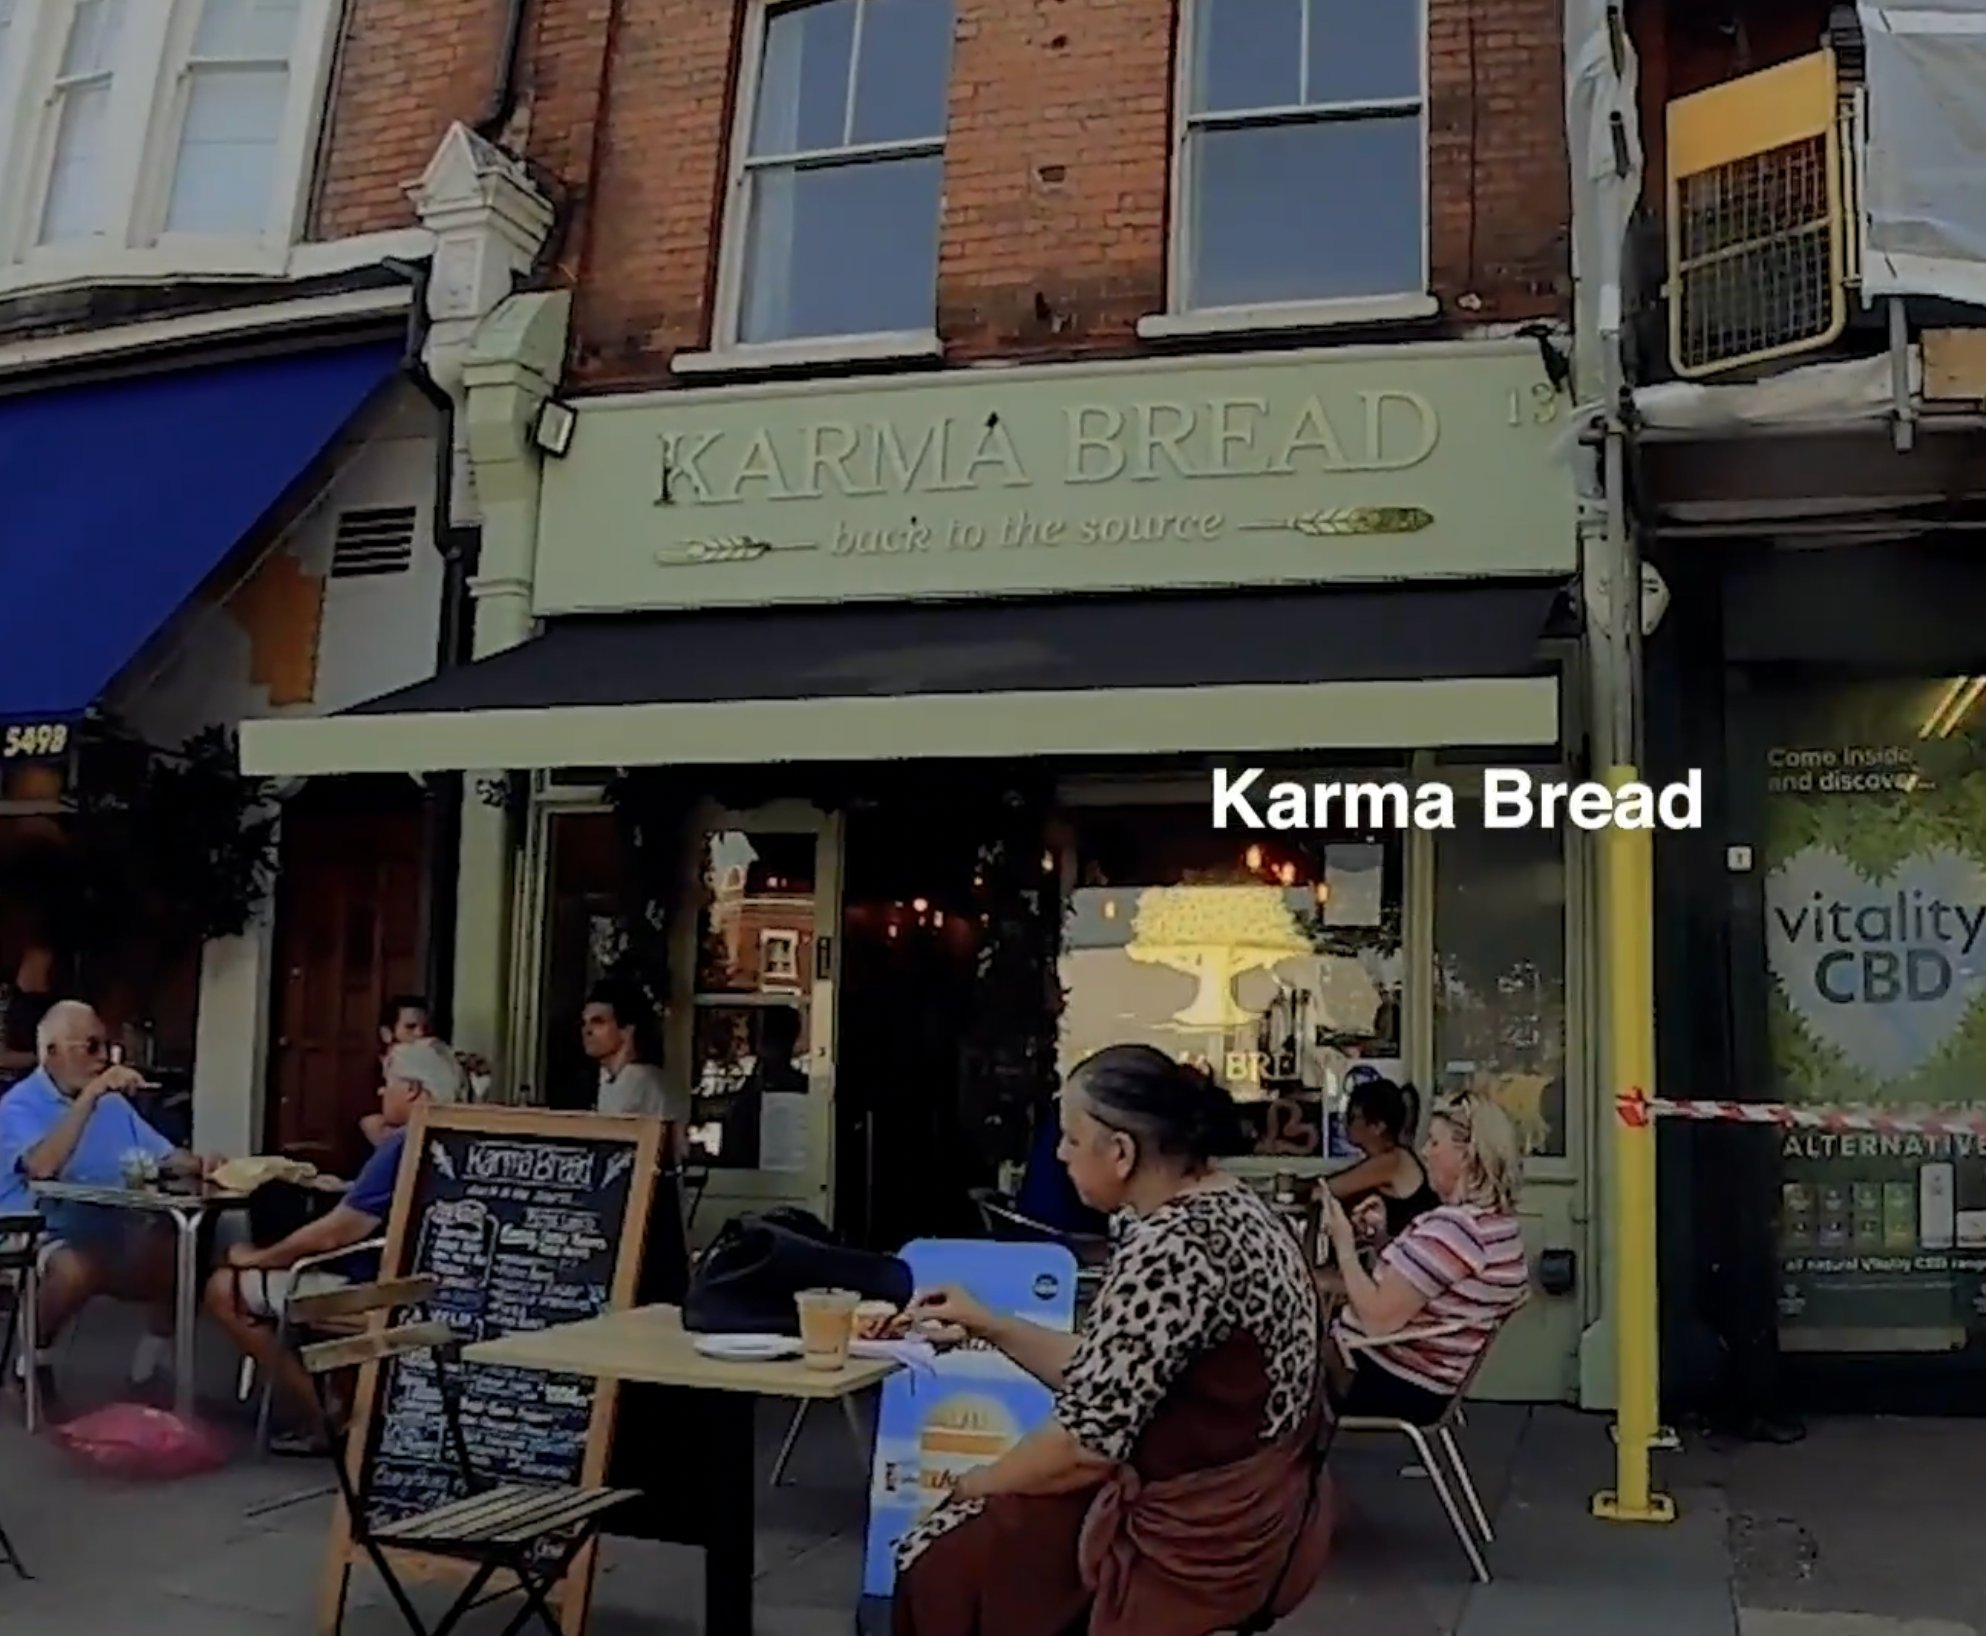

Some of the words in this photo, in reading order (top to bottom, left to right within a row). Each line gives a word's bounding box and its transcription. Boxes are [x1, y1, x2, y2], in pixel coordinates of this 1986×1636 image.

[653, 412, 1033, 506] KARMA
[1062, 389, 1440, 485] BREAD
[830, 516, 932, 557] back
[945, 517, 987, 549] to
[1000, 509, 1066, 547] the
[1080, 509, 1225, 547] source
[1774, 890, 1986, 954] vitality
[1814, 949, 1953, 1003] CBD
